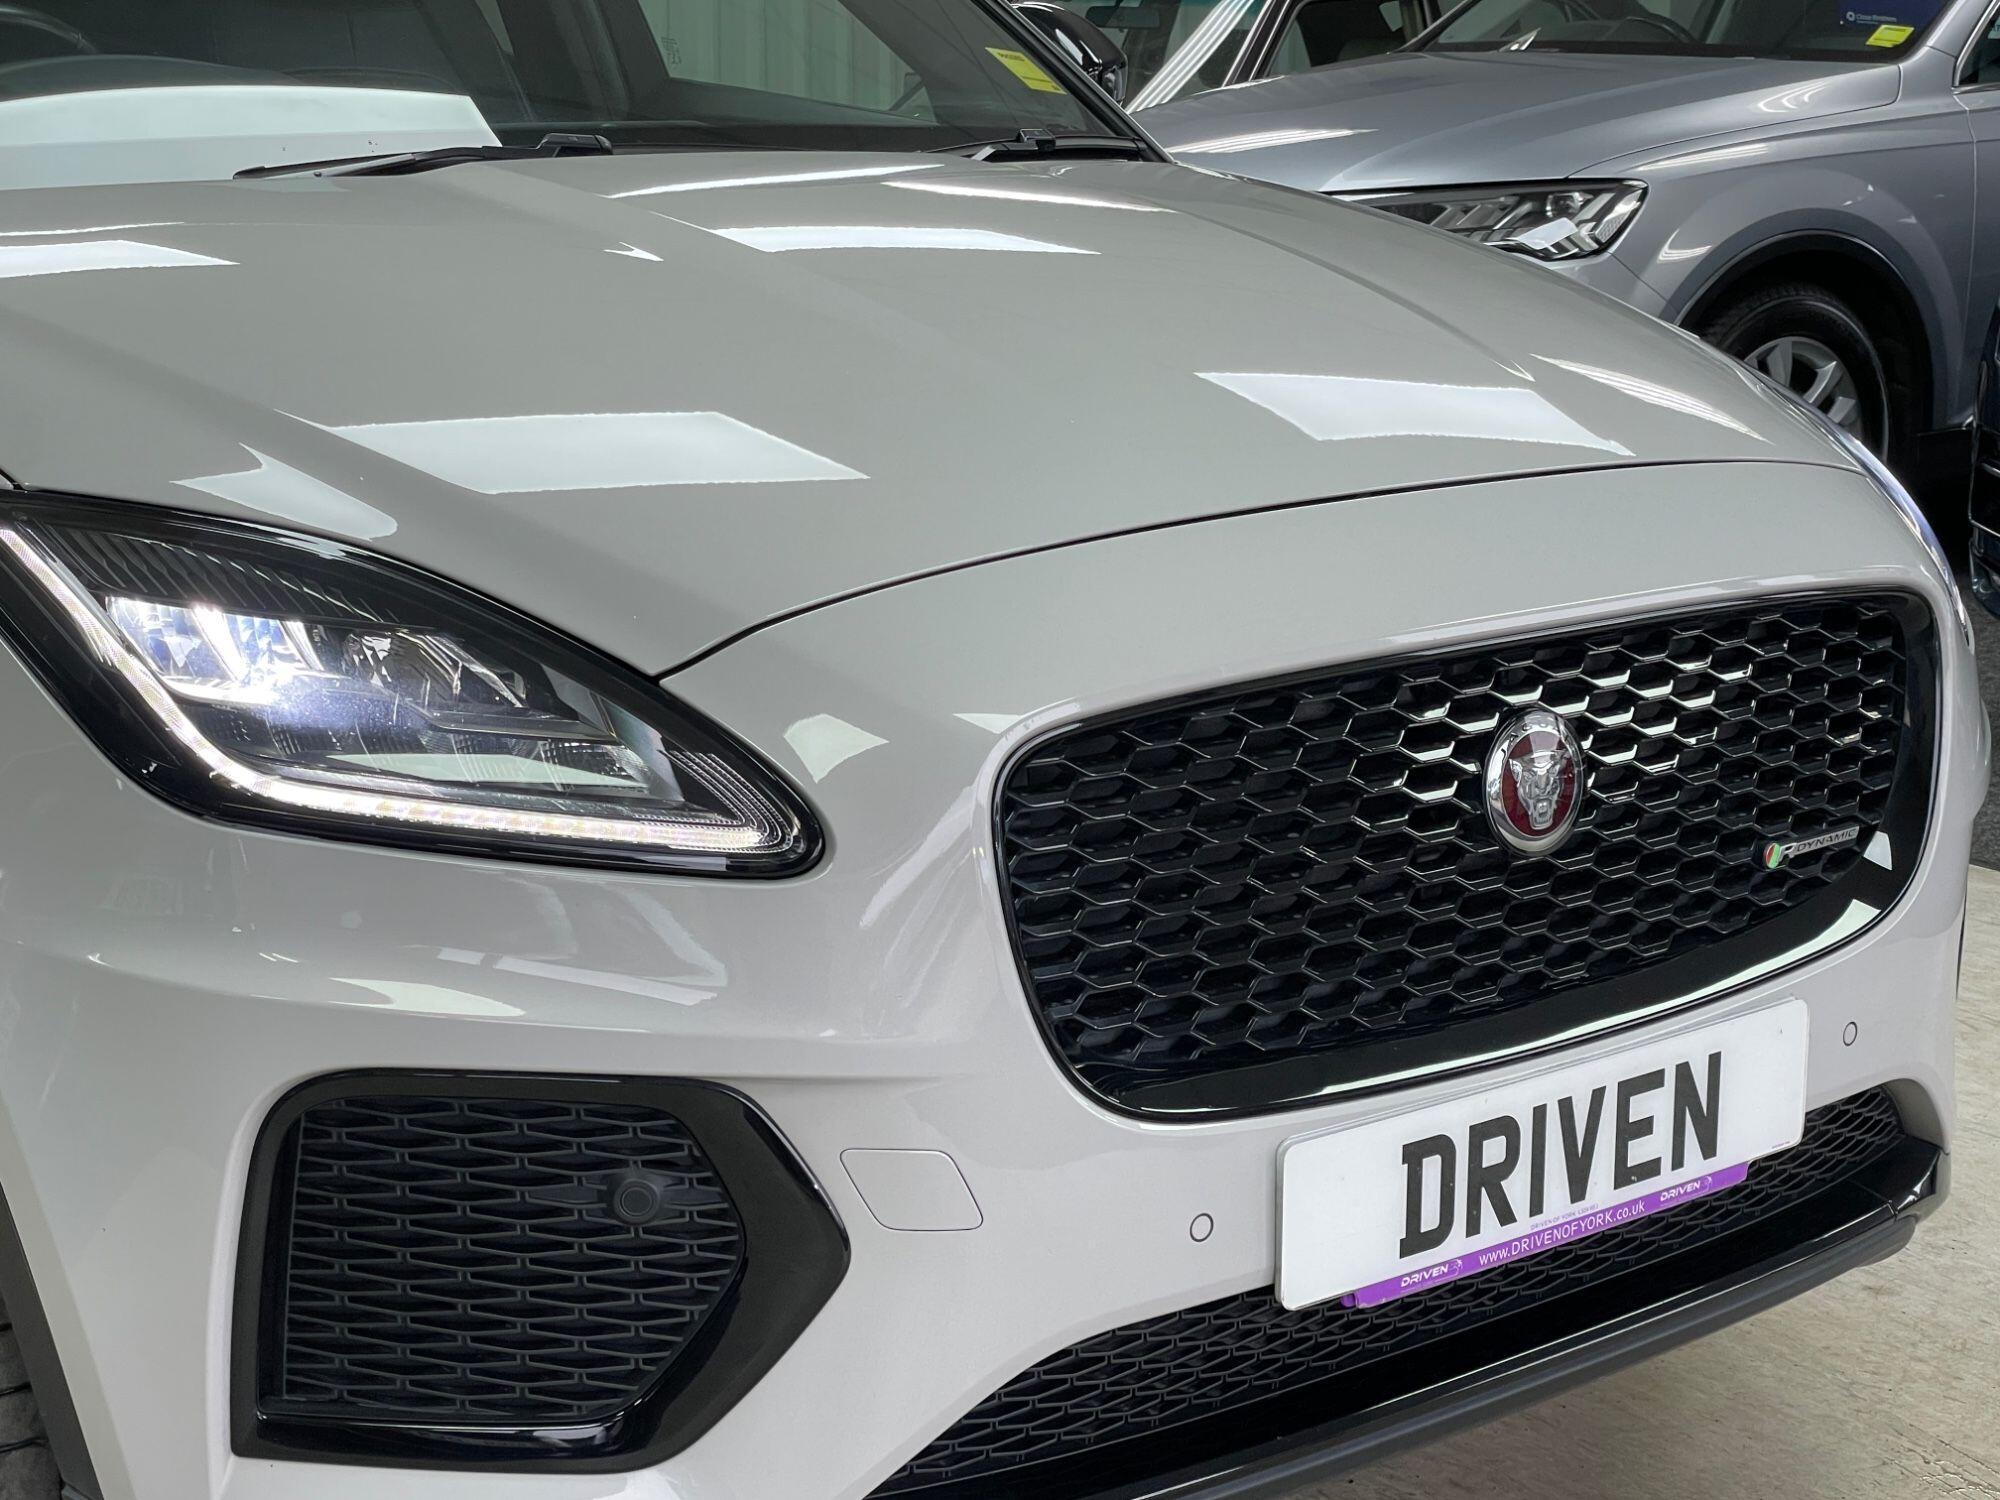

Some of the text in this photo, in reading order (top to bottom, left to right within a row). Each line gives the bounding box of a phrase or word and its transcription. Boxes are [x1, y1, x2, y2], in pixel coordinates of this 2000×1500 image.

[1398, 1051, 1722, 1260] DRIVEN
[1660, 1180, 1701, 1202] DRIVEN
[1478, 1199, 1646, 1266] www.DRIVENOFYORK.co.uk
[1400, 1264, 1450, 1287] DRIVEN
